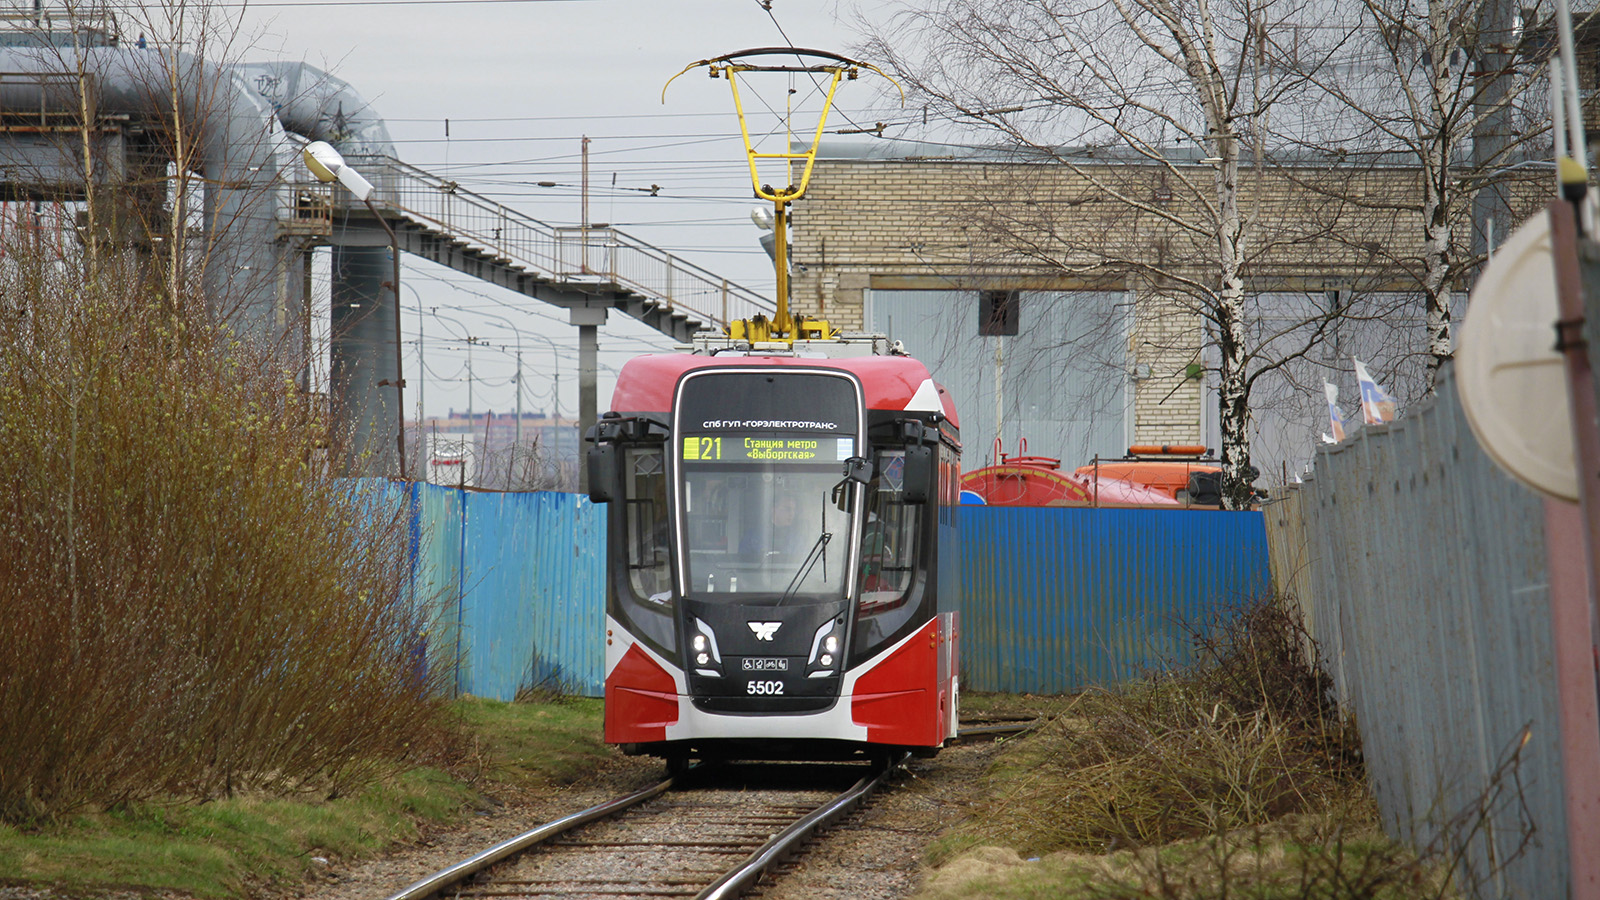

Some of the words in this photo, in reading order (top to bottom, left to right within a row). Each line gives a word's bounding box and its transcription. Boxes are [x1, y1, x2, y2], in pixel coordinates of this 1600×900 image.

[702, 421, 722, 429] СПб
[722, 420, 741, 428] ГУП
[742, 420, 838, 430] «ГОРЭЛЕКТРОТРАНС»
[701, 437, 722, 460] 21
[744, 437, 783, 449] Станция
[786, 439, 818, 449] метро
[747, 448, 816, 460] «Выборгская»
[747, 681, 784, 696] 5502
